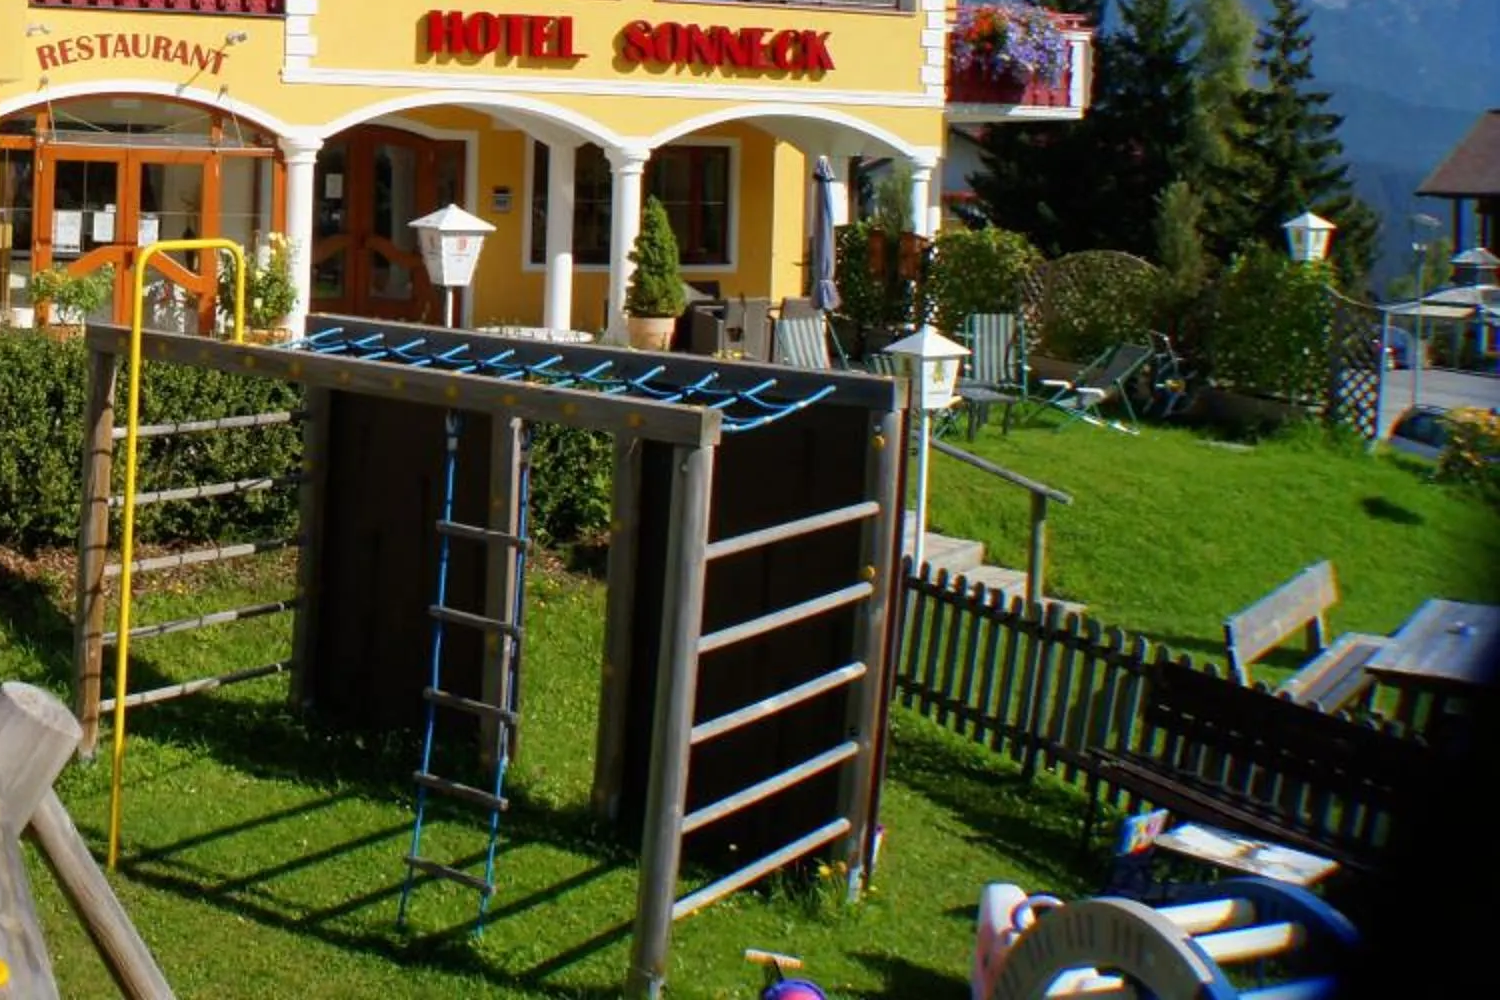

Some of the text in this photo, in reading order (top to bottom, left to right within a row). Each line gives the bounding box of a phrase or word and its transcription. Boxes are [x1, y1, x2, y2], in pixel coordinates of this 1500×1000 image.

[36, 33, 228, 75] RESTAURANT
[426, 10, 835, 71] HOTEL SONNECK
